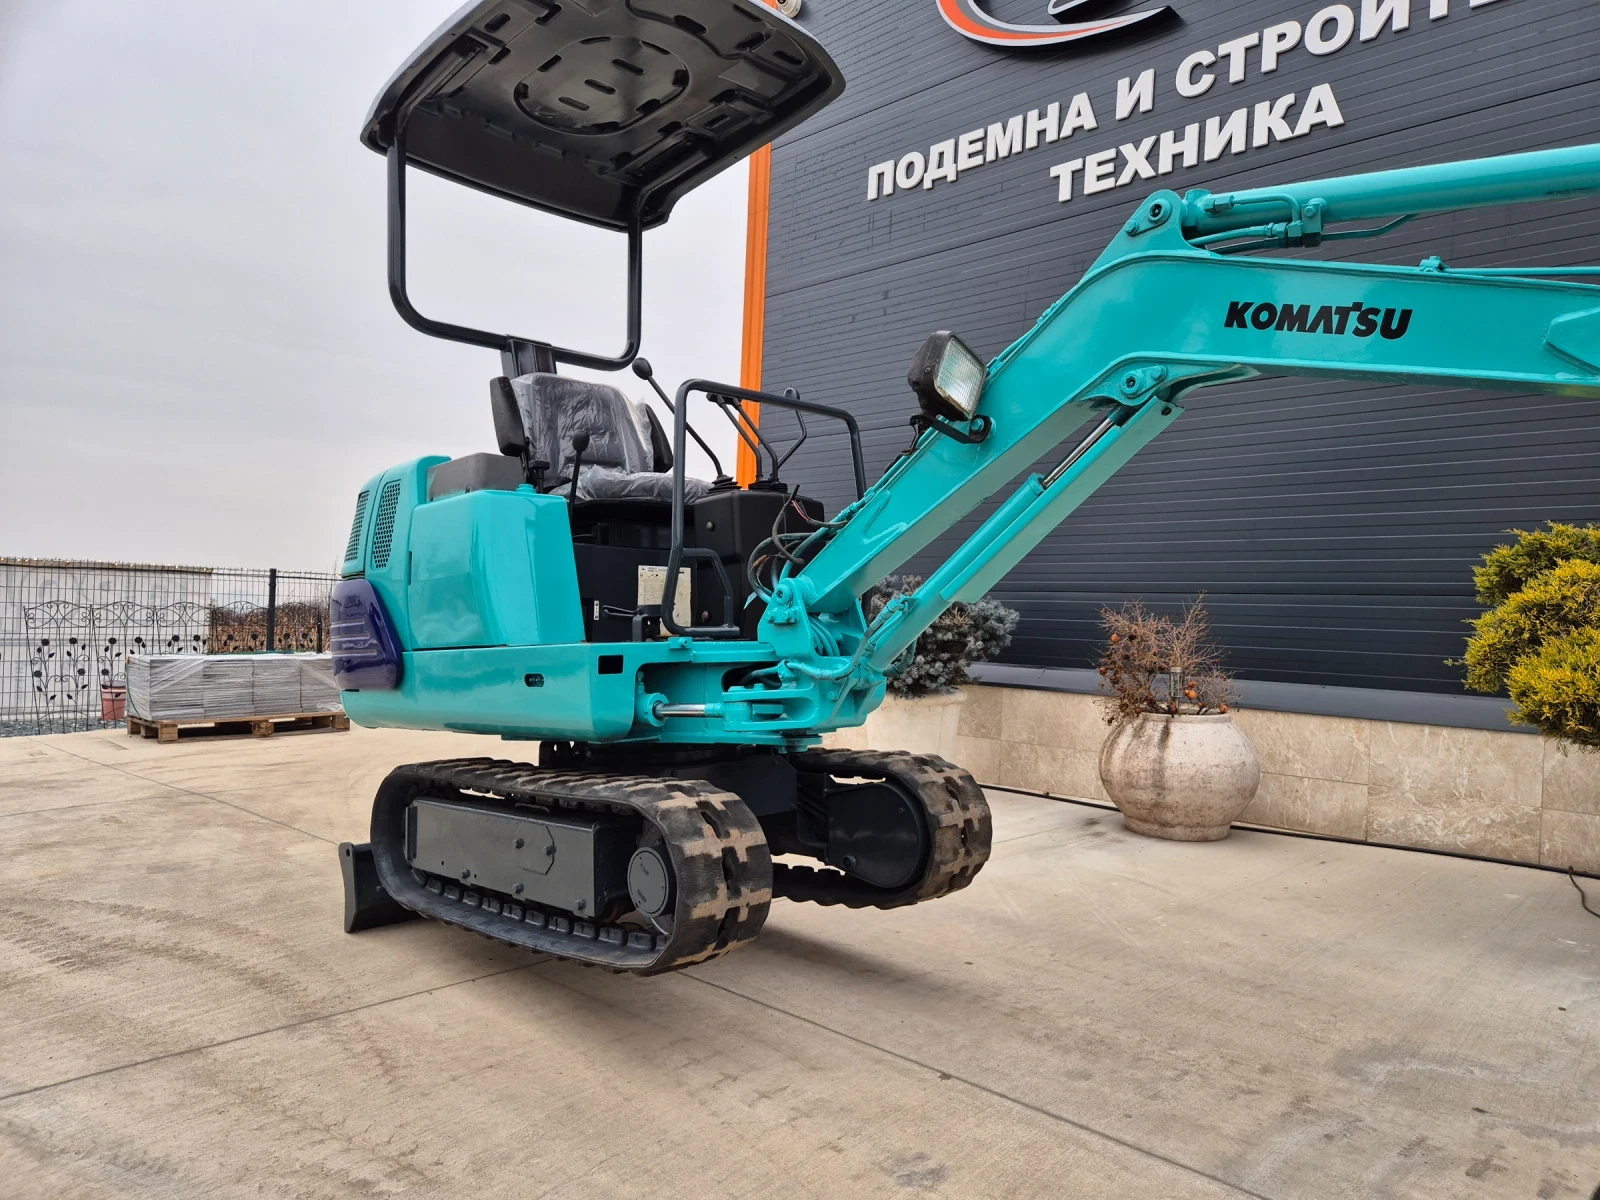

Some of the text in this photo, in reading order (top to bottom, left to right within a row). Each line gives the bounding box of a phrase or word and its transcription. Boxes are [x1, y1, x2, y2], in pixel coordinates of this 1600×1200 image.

[867, 0, 1497, 201] ПОДЕМНА И СТРОИ
[1049, 82, 1346, 203] ТЕХНИКА
[1224, 301, 1414, 341] KOMATSU
